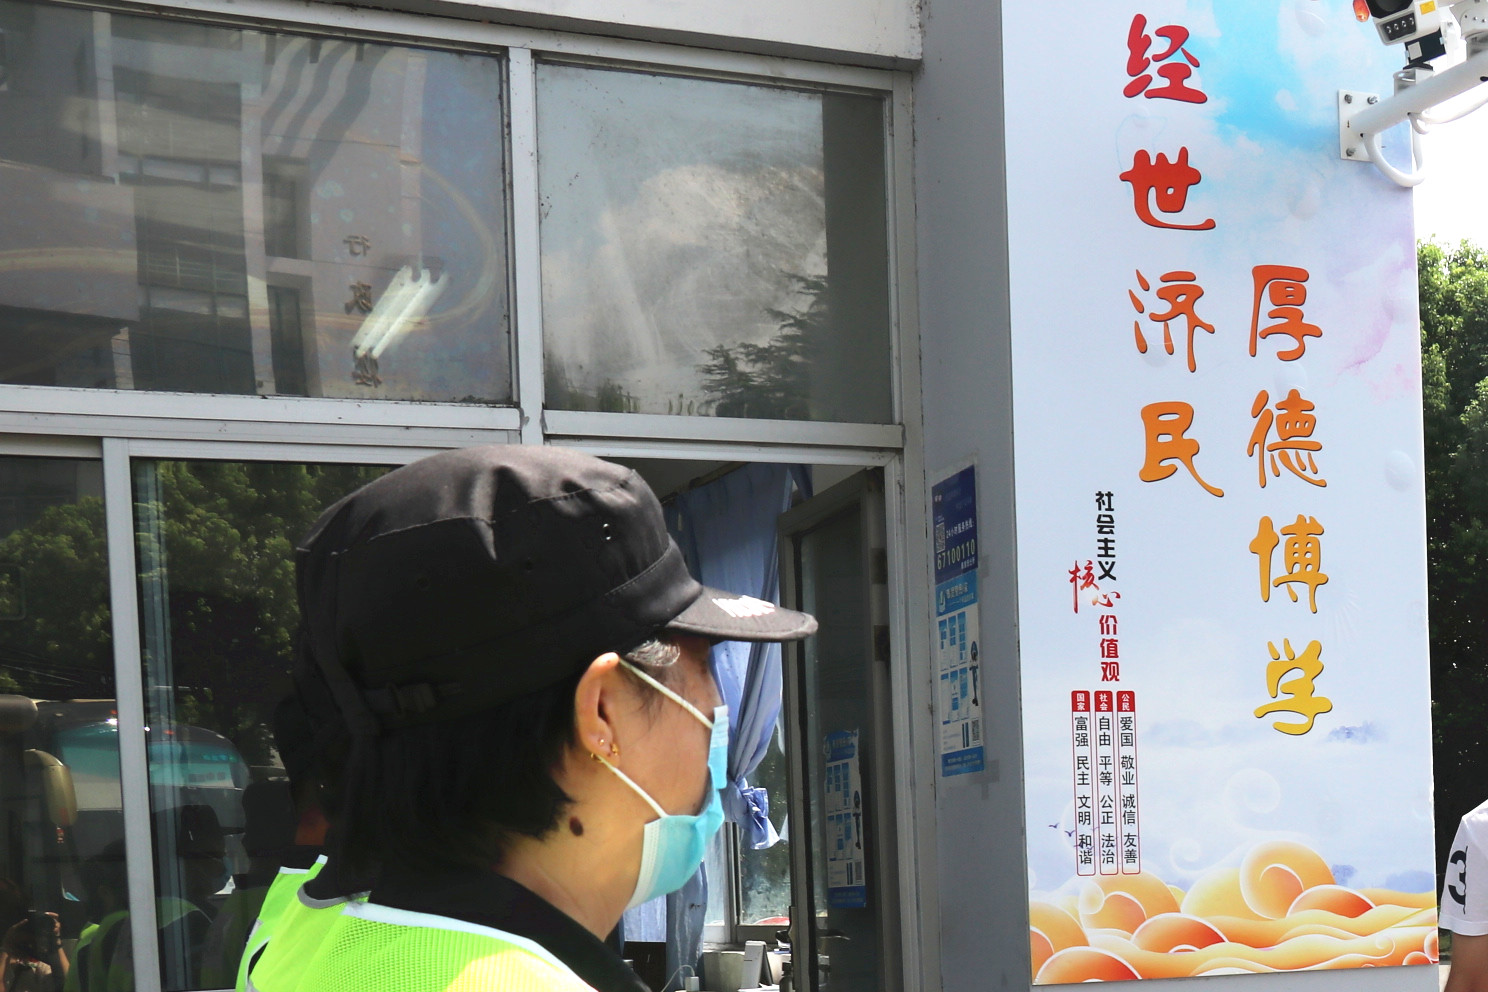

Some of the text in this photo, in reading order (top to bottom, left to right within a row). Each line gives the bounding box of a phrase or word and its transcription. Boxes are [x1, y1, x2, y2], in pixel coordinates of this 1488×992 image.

[1119, 13, 1225, 498] 经世济民
[1095, 490, 1117, 582] 社会主义
[1246, 264, 1333, 736] 厚德博学
[936, 538, 976, 571] 67100110
[1099, 614, 1121, 682] 价值观
[1076, 693, 1086, 711] 国家
[1099, 693, 1108, 711] 社会
[1121, 693, 1130, 711] 公民
[1075, 716, 1093, 866] 富强 民主 文明 和谐
[1099, 716, 1115, 865] 自由 平等 公正 法治
[1120, 716, 1138, 864] 爱国 敬业 诚信 友善
